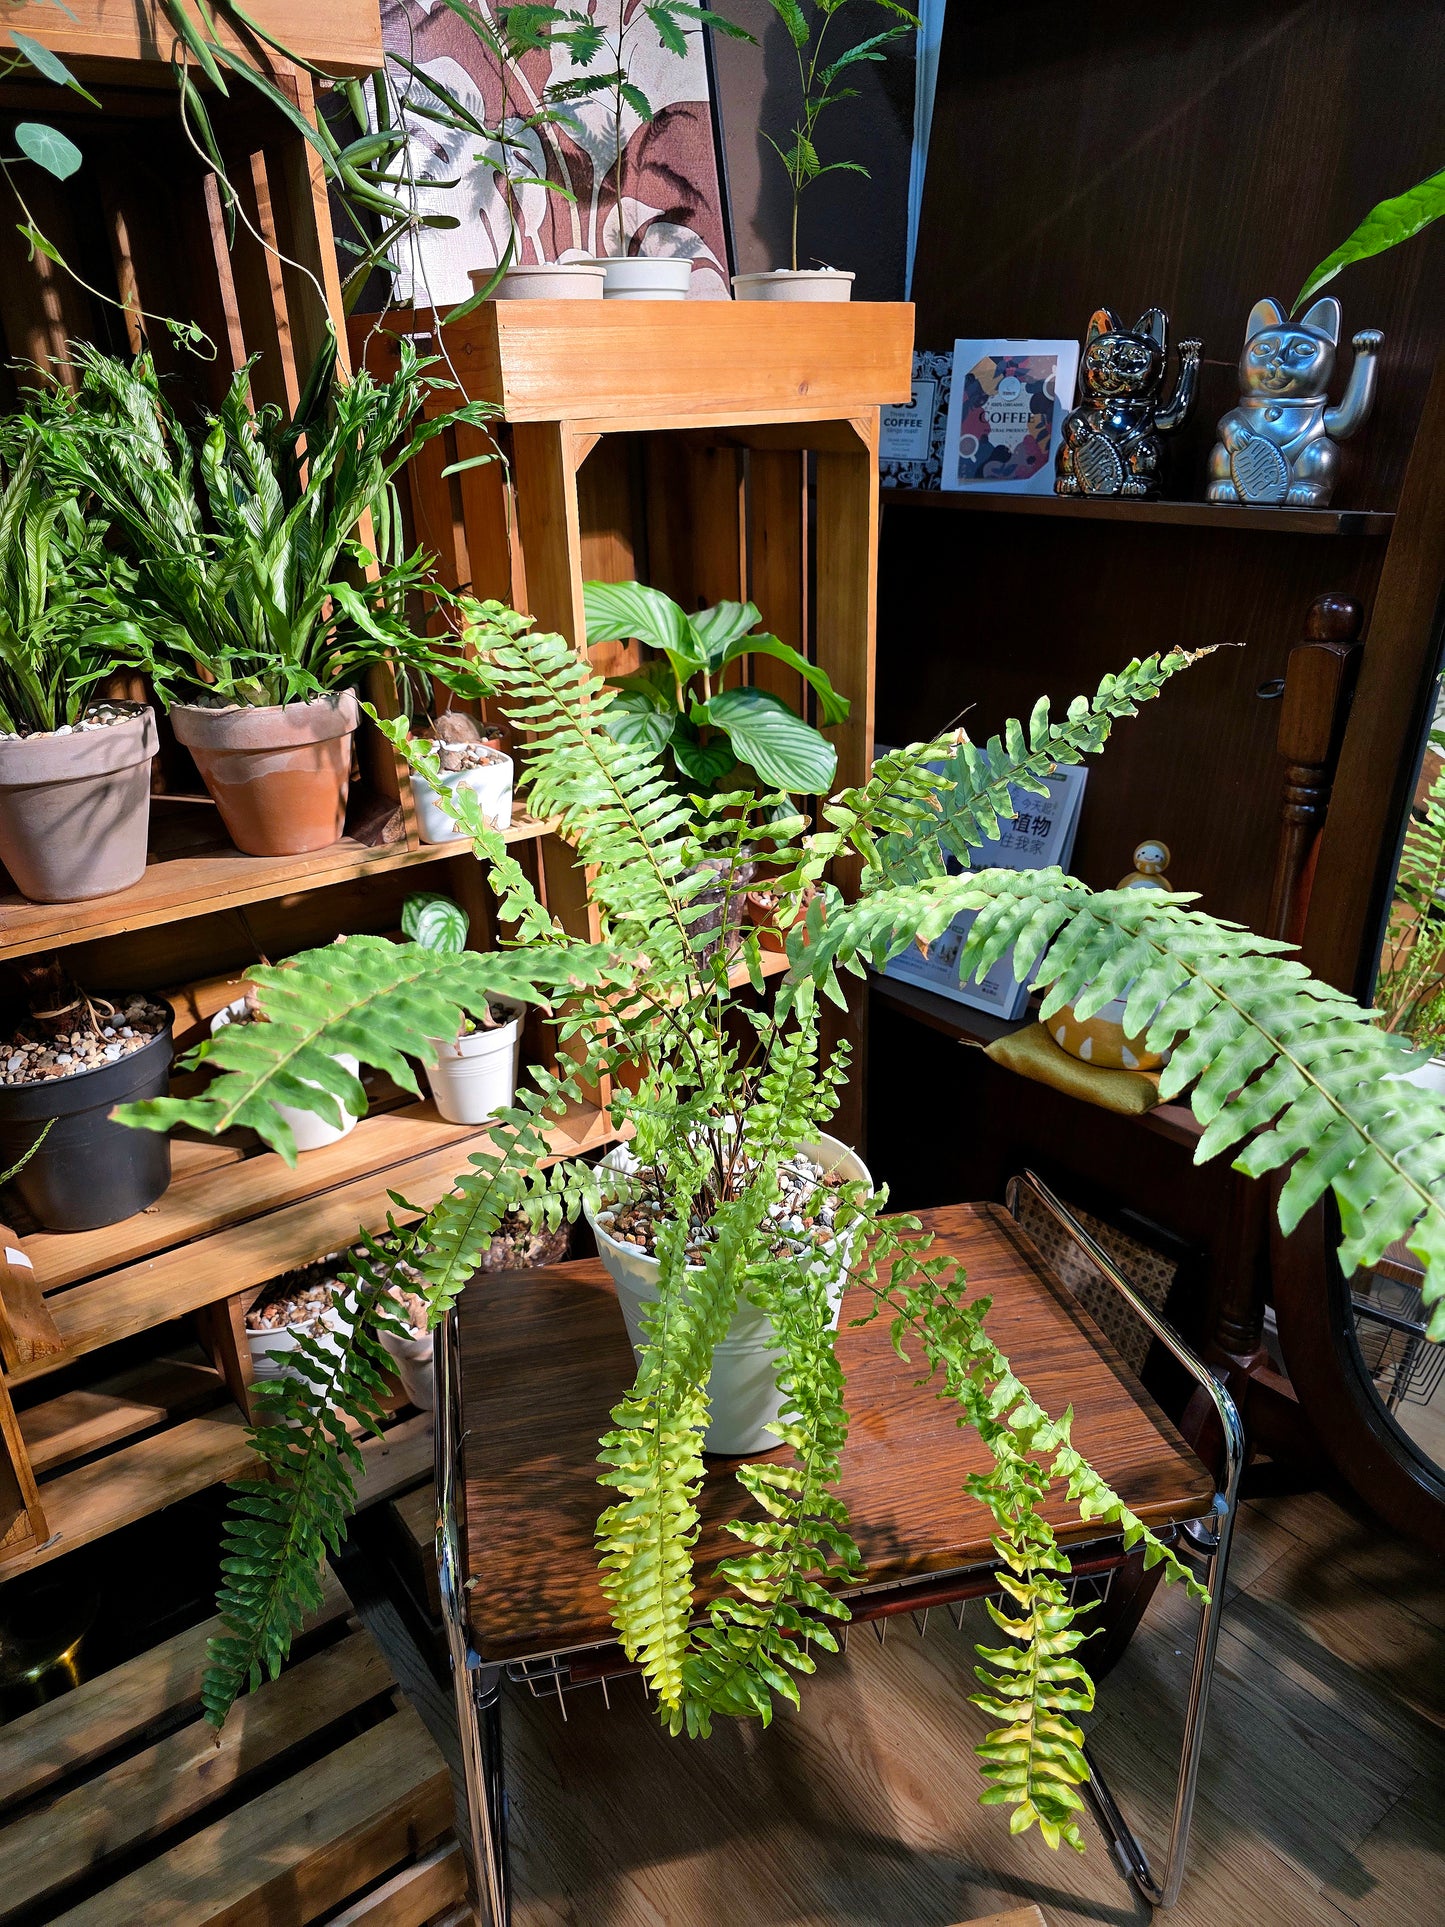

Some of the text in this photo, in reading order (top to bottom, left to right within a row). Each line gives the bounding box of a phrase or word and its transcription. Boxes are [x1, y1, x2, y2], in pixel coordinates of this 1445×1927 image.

[884, 418, 923, 428] COFFEE
[979, 411, 1035, 424] COFFEE
[1011, 810, 1052, 838] 植物
[999, 832, 1045, 855] 住我家
